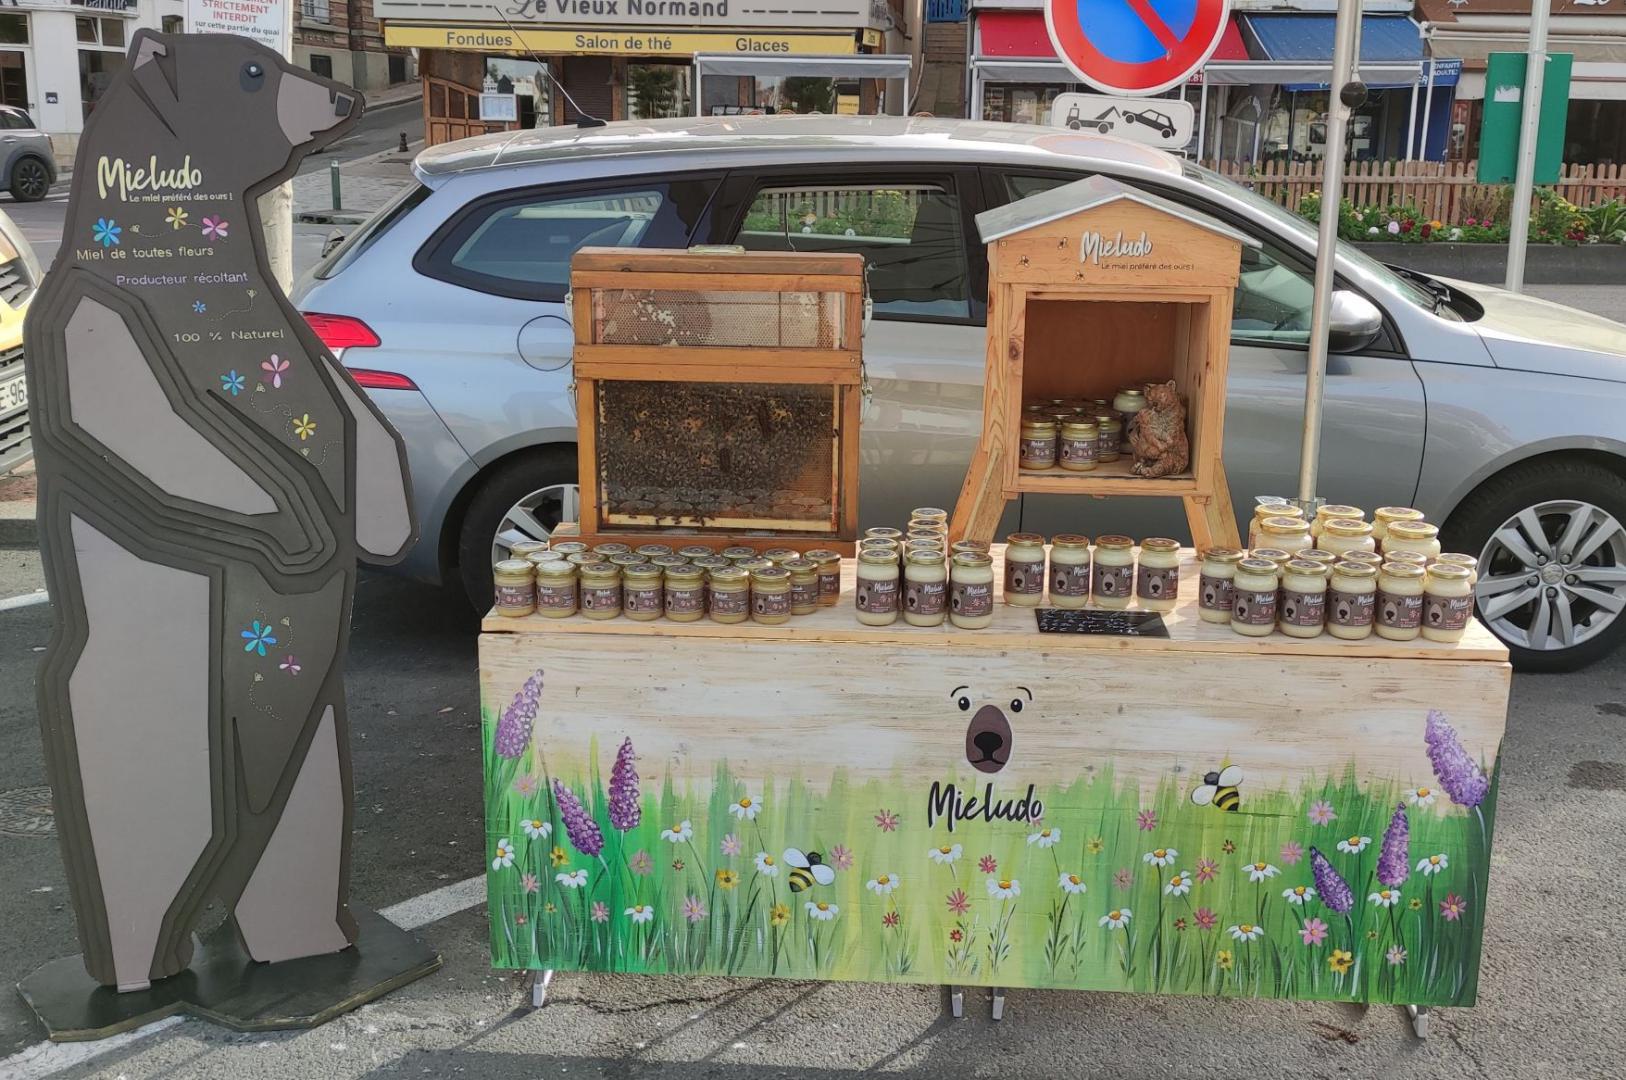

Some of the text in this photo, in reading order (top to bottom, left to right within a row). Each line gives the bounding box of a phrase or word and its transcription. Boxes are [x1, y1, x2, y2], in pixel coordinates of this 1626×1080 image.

[202, 0, 270, 14] STRICTEMENT
[556, 0, 618, 16] Vieux
[627, 0, 729, 17] Normand
[213, 11, 258, 23] INTERDIT
[262, 28, 280, 36] quai
[446, 32, 513, 47] Fondues
[575, 34, 672, 50] Salon de thé
[735, 38, 789, 52] Glaces
[97, 154, 202, 202] Mieludo
[129, 194, 140, 202] Le
[142, 193, 161, 202] miel
[162, 193, 192, 203] préféré
[193, 192, 208, 200] des
[76, 246, 214, 261] Miel de toutes fleurs
[1081, 231, 1153, 265] Mieludo
[116, 272, 248, 286] Producteur récoltant
[174, 329, 284, 342] 100 % Naturel
[927, 780, 1043, 832] Mieludo
